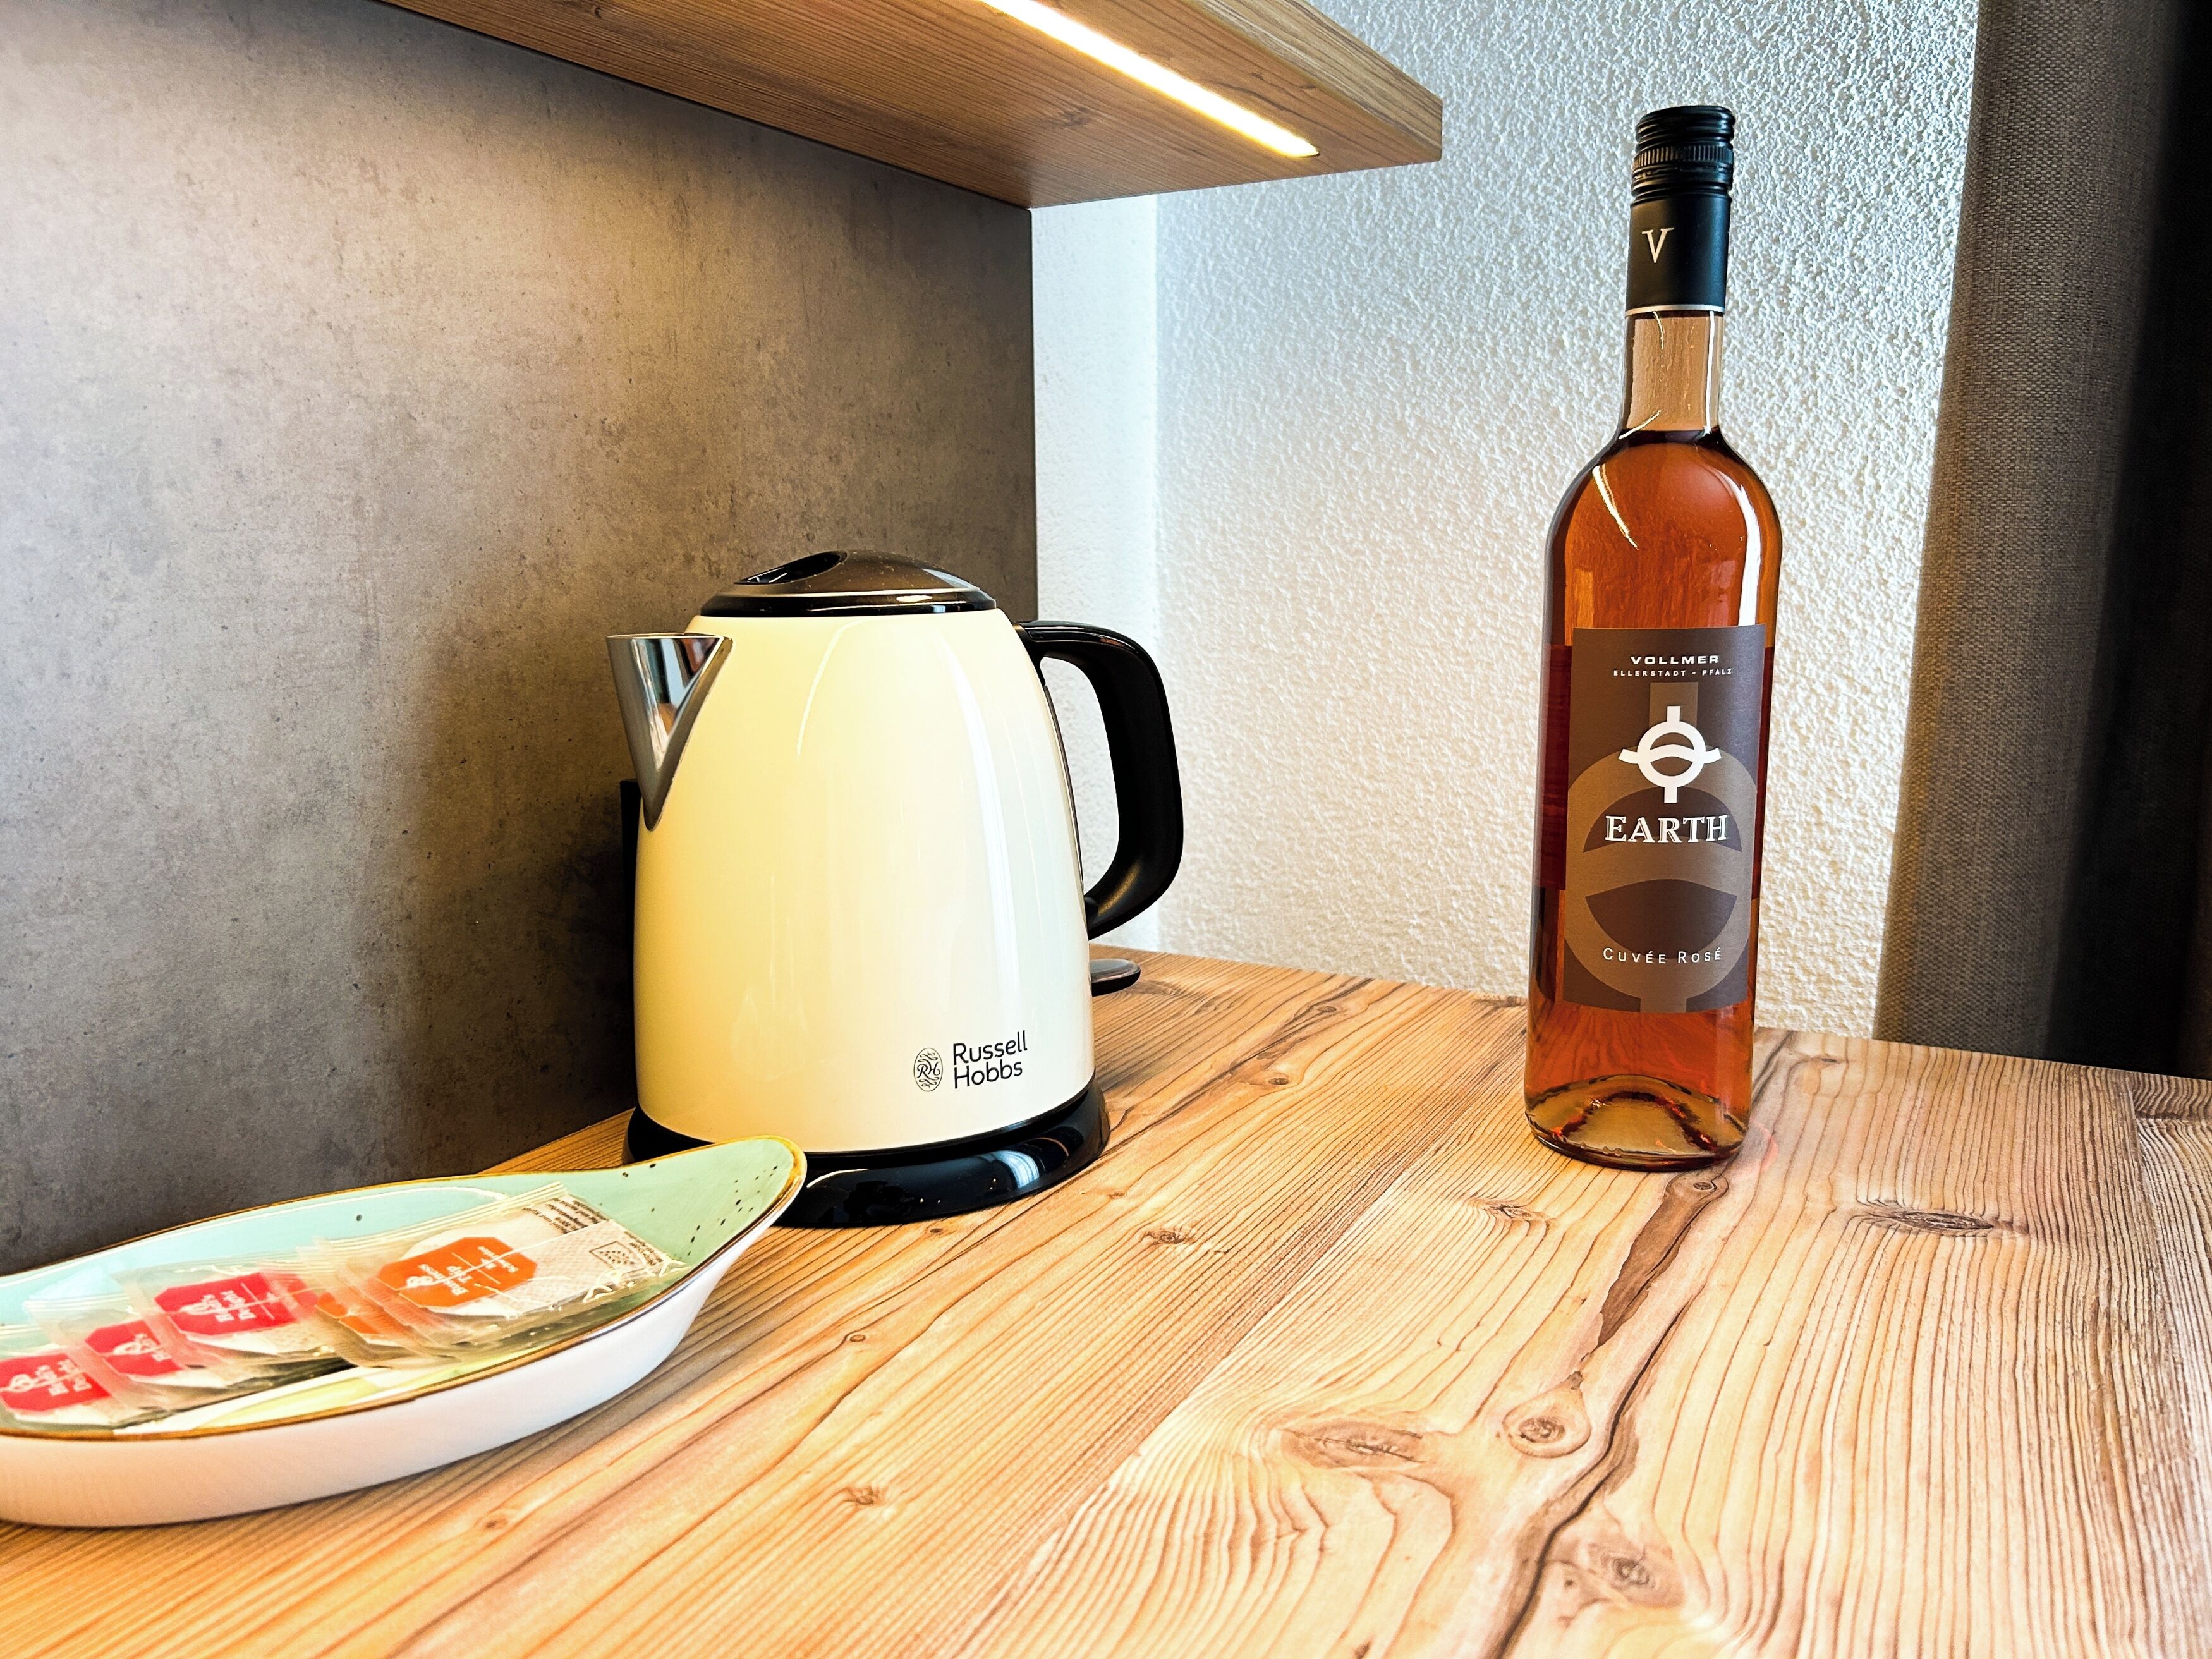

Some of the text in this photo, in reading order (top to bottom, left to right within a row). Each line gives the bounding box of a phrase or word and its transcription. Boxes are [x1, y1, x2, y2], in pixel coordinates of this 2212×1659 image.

[1642, 227, 1674, 263] V
[1631, 655, 1718, 665] VOLLMER
[1702, 668, 1732, 676] PFALZ
[1605, 815, 1729, 844] EARTH
[953, 1030, 1028, 1065] Russell
[954, 1059, 1023, 1089] Hobbs
[418, 1263, 469, 1296] Busness
[446, 1265, 473, 1283] Tip
[220, 1290, 257, 1320] Deight
